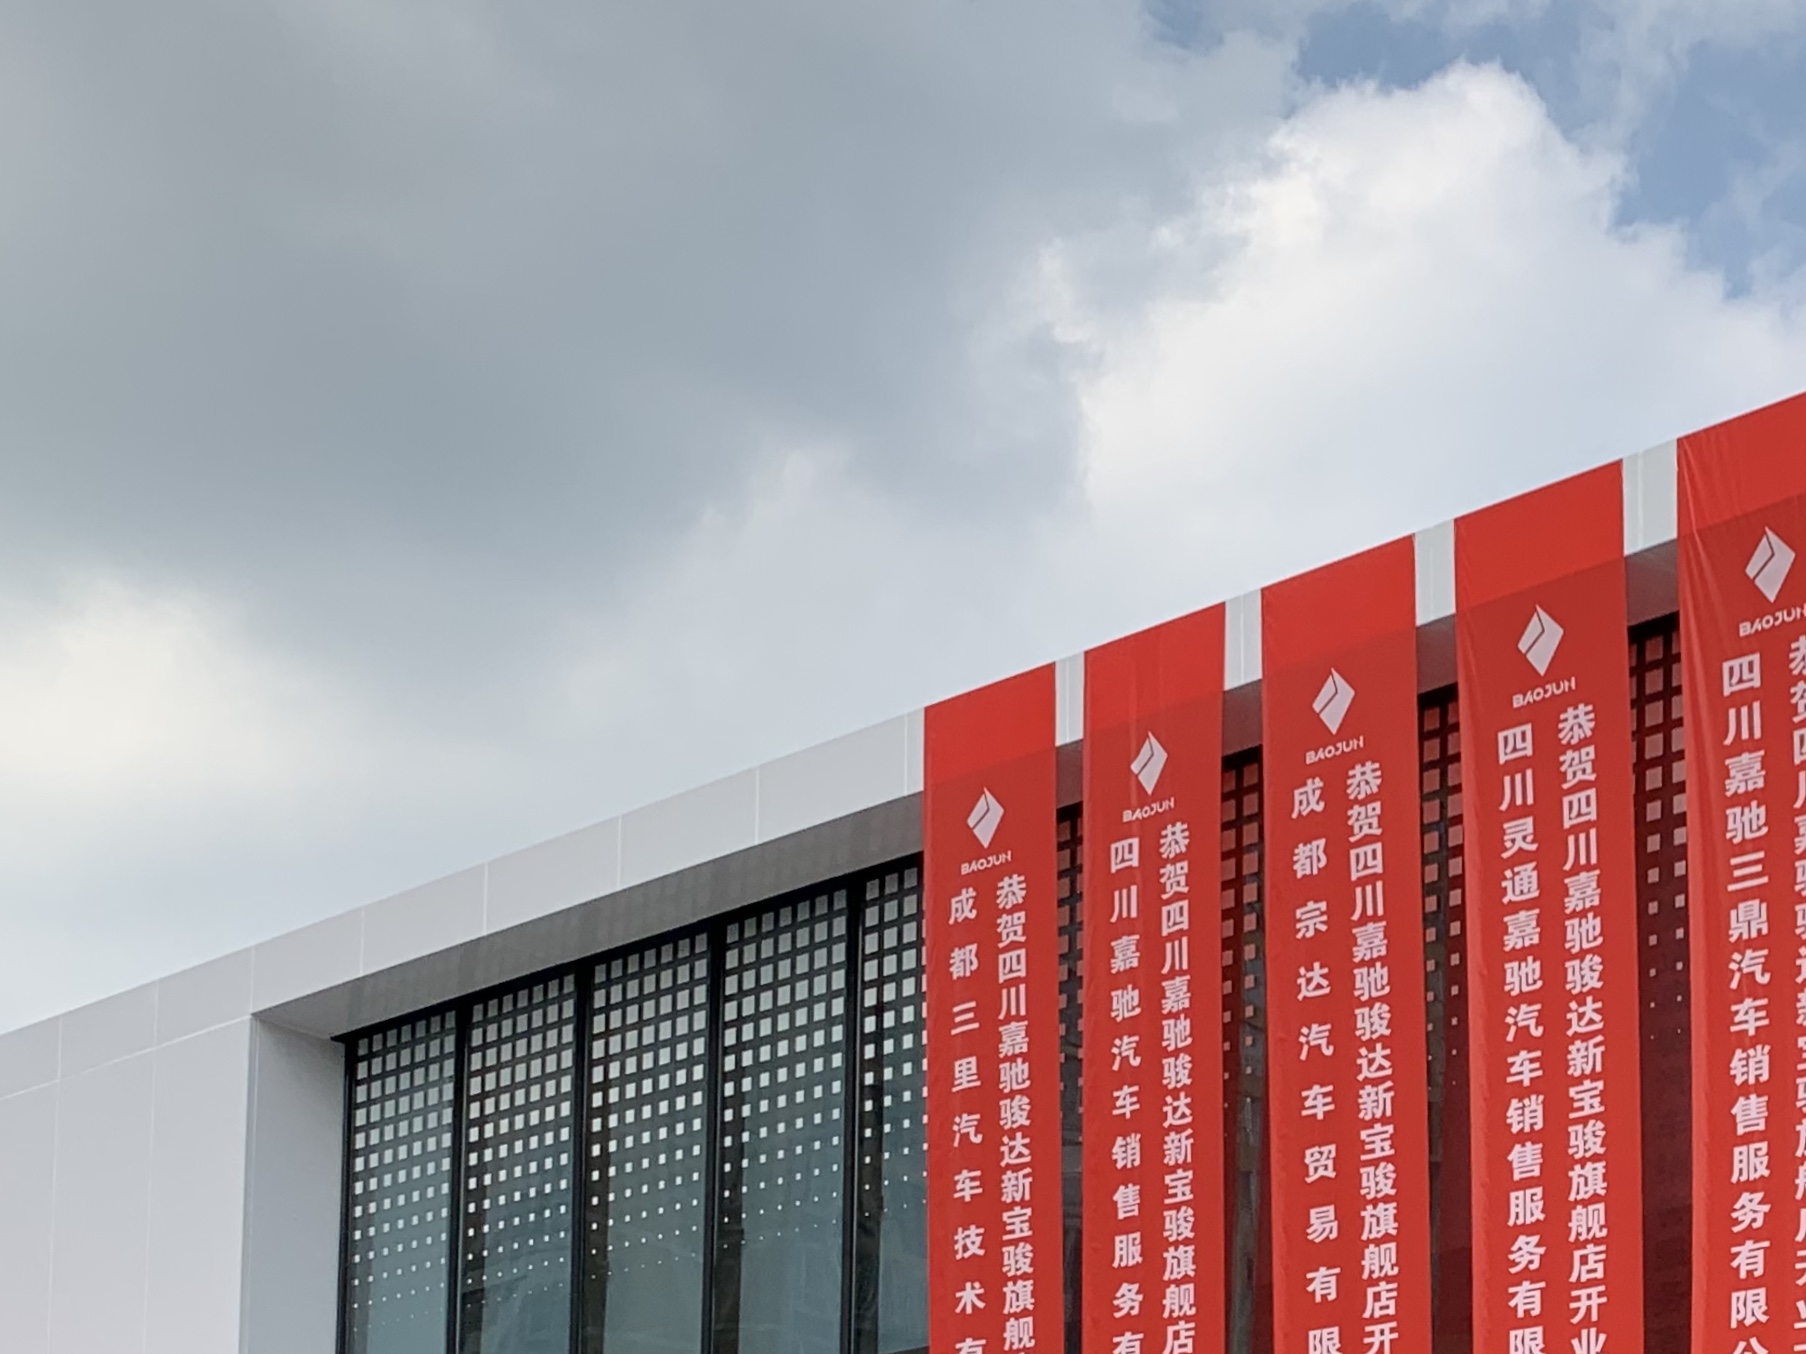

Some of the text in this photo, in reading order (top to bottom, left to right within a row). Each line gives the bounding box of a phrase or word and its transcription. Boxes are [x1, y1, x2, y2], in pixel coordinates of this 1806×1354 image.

[1511, 678, 1576, 708] BAOJUN
[1305, 735, 1364, 764] BAOJUN
[1123, 798, 1175, 822] BAOJUN
[961, 852, 1011, 873] BAOJUN
